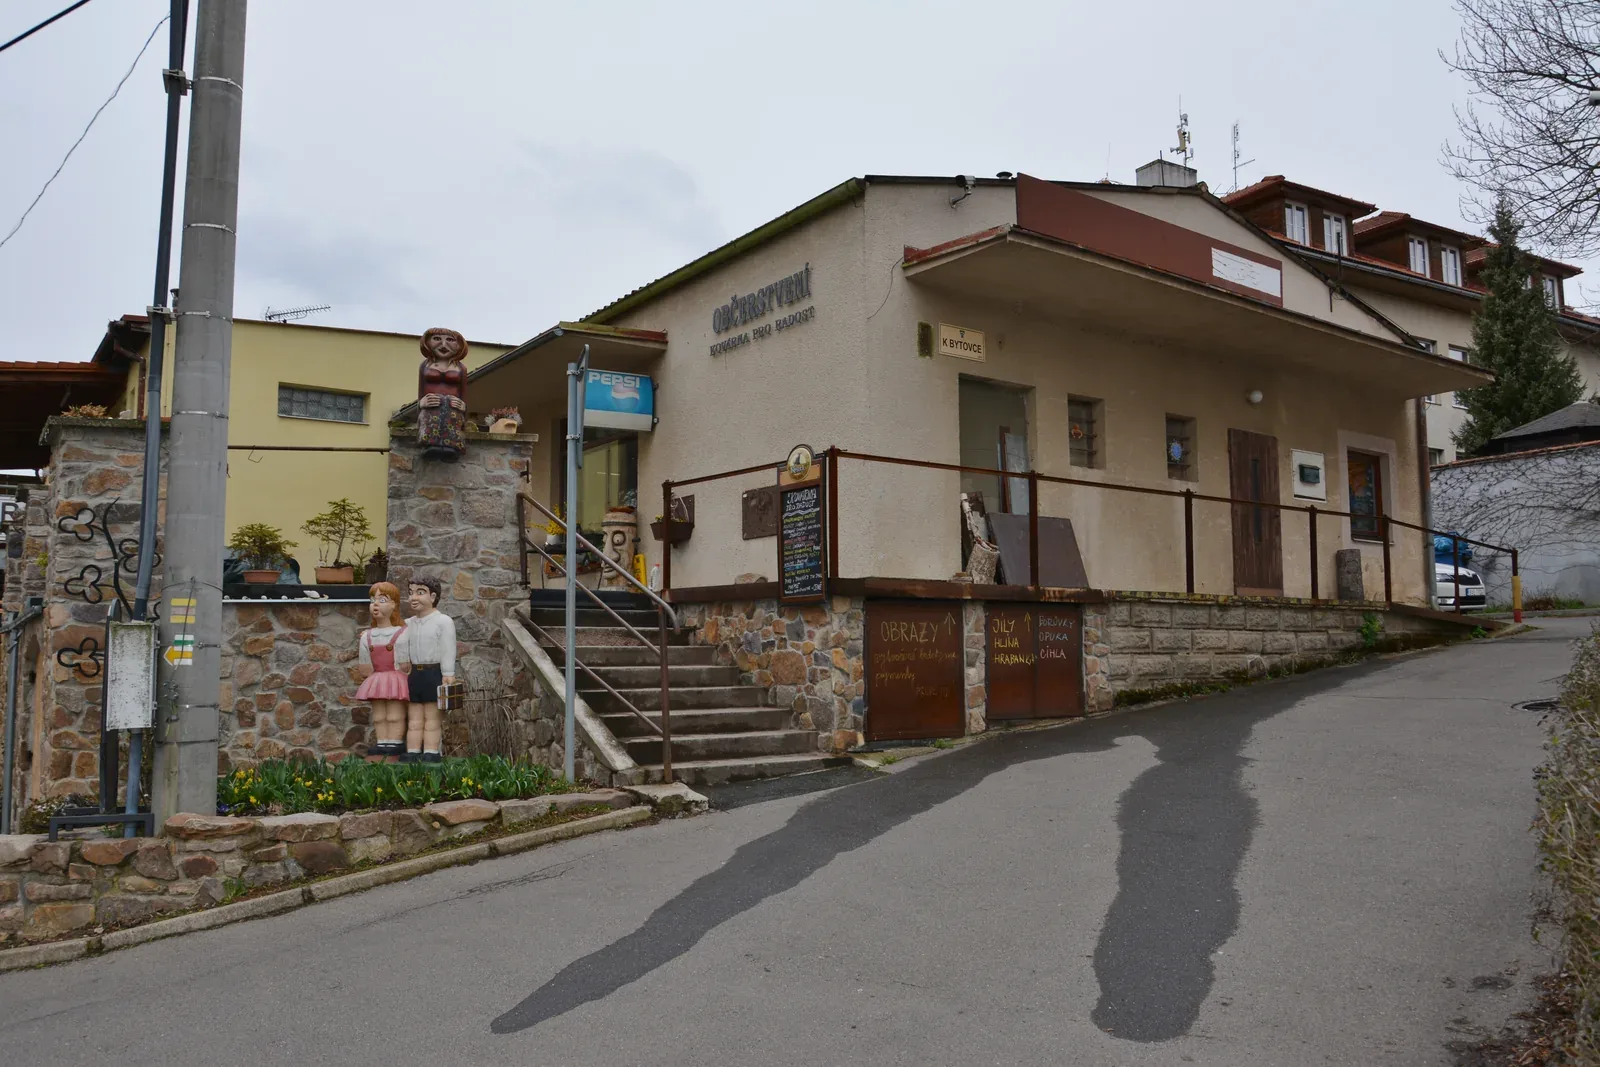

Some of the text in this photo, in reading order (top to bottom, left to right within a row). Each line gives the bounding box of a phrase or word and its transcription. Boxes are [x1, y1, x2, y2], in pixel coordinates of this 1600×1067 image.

[712, 262, 811, 333] OBČERSTVENÍ
[752, 323, 772, 340] PRO
[775, 305, 815, 331] RADOST
[942, 337, 982, 353] K BYTOVCE
[588, 371, 641, 388] PEPSI
[880, 621, 939, 642] OBRAZY
[1039, 631, 1069, 642] OPUKA
